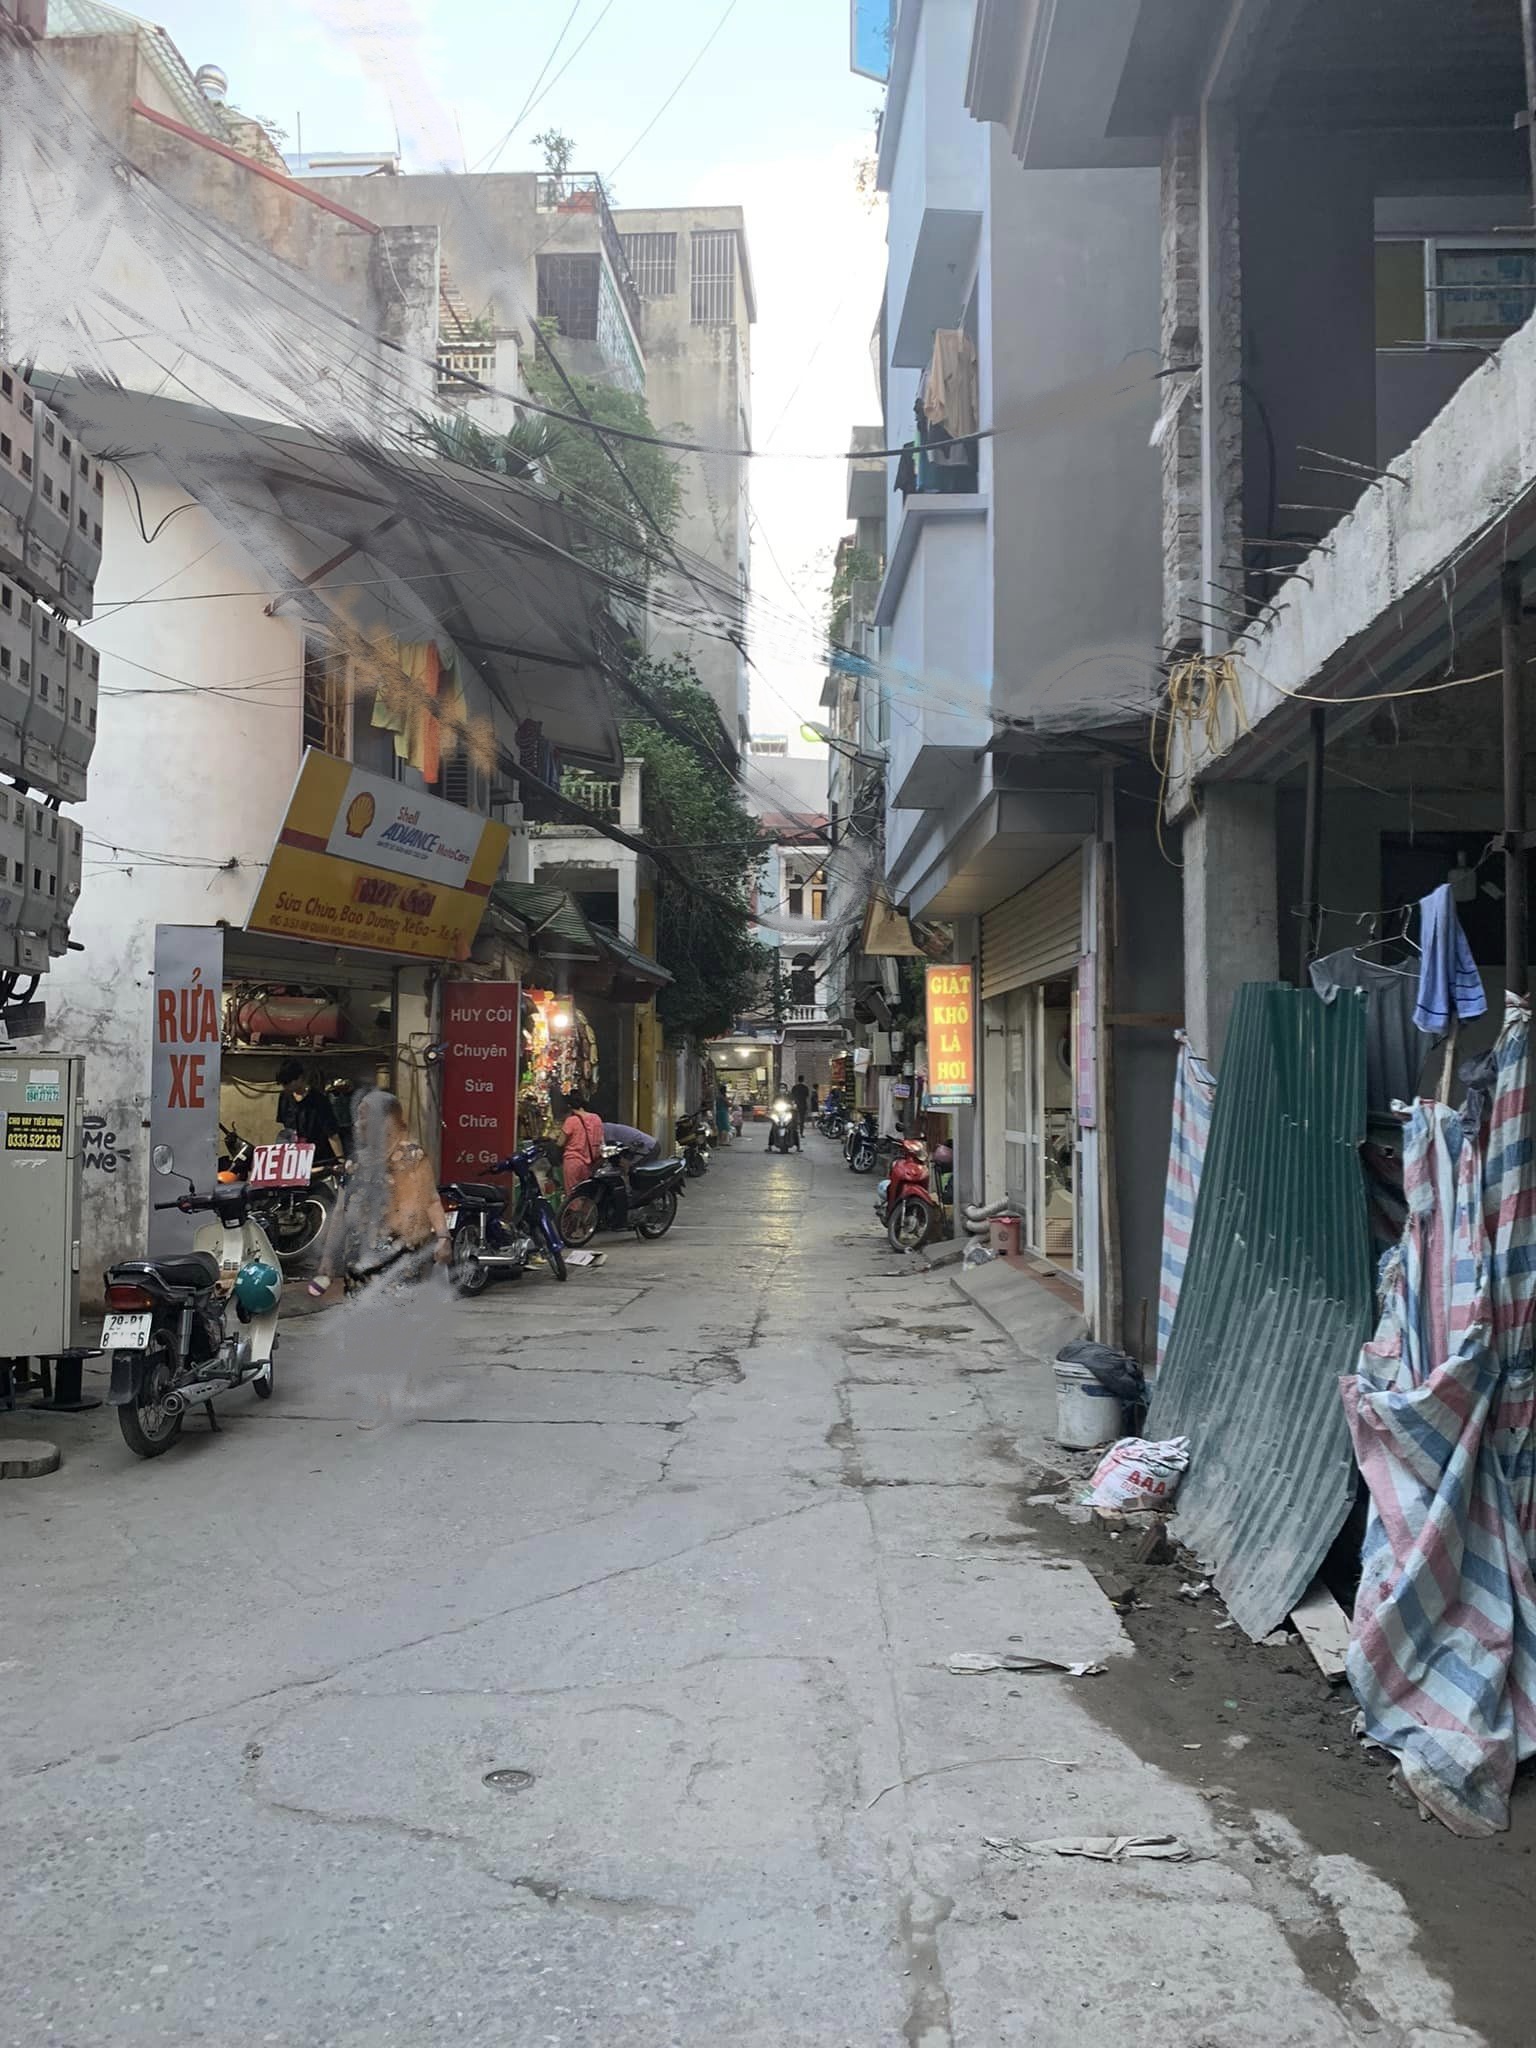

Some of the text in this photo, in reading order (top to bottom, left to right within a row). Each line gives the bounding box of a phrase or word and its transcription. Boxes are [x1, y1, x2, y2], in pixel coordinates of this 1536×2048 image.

[397, 806, 421, 825] Shell
[380, 822, 440, 852] ADVANCE
[931, 972, 971, 998] GIẶT
[158, 967, 219, 1043] RỬA
[451, 1009, 482, 1022] HUY
[933, 1002, 968, 1024] KHÔ
[453, 1044, 507, 1060] Chuyên
[168, 1055, 206, 1108] XE
[459, 1114, 497, 1128] Chữa
[8, 1133, 61, 1148] 0333.522.833
[250, 1149, 281, 1181] XE
[479, 1150, 498, 1163] Ga
[1127, 1470, 1166, 1496] AAA
